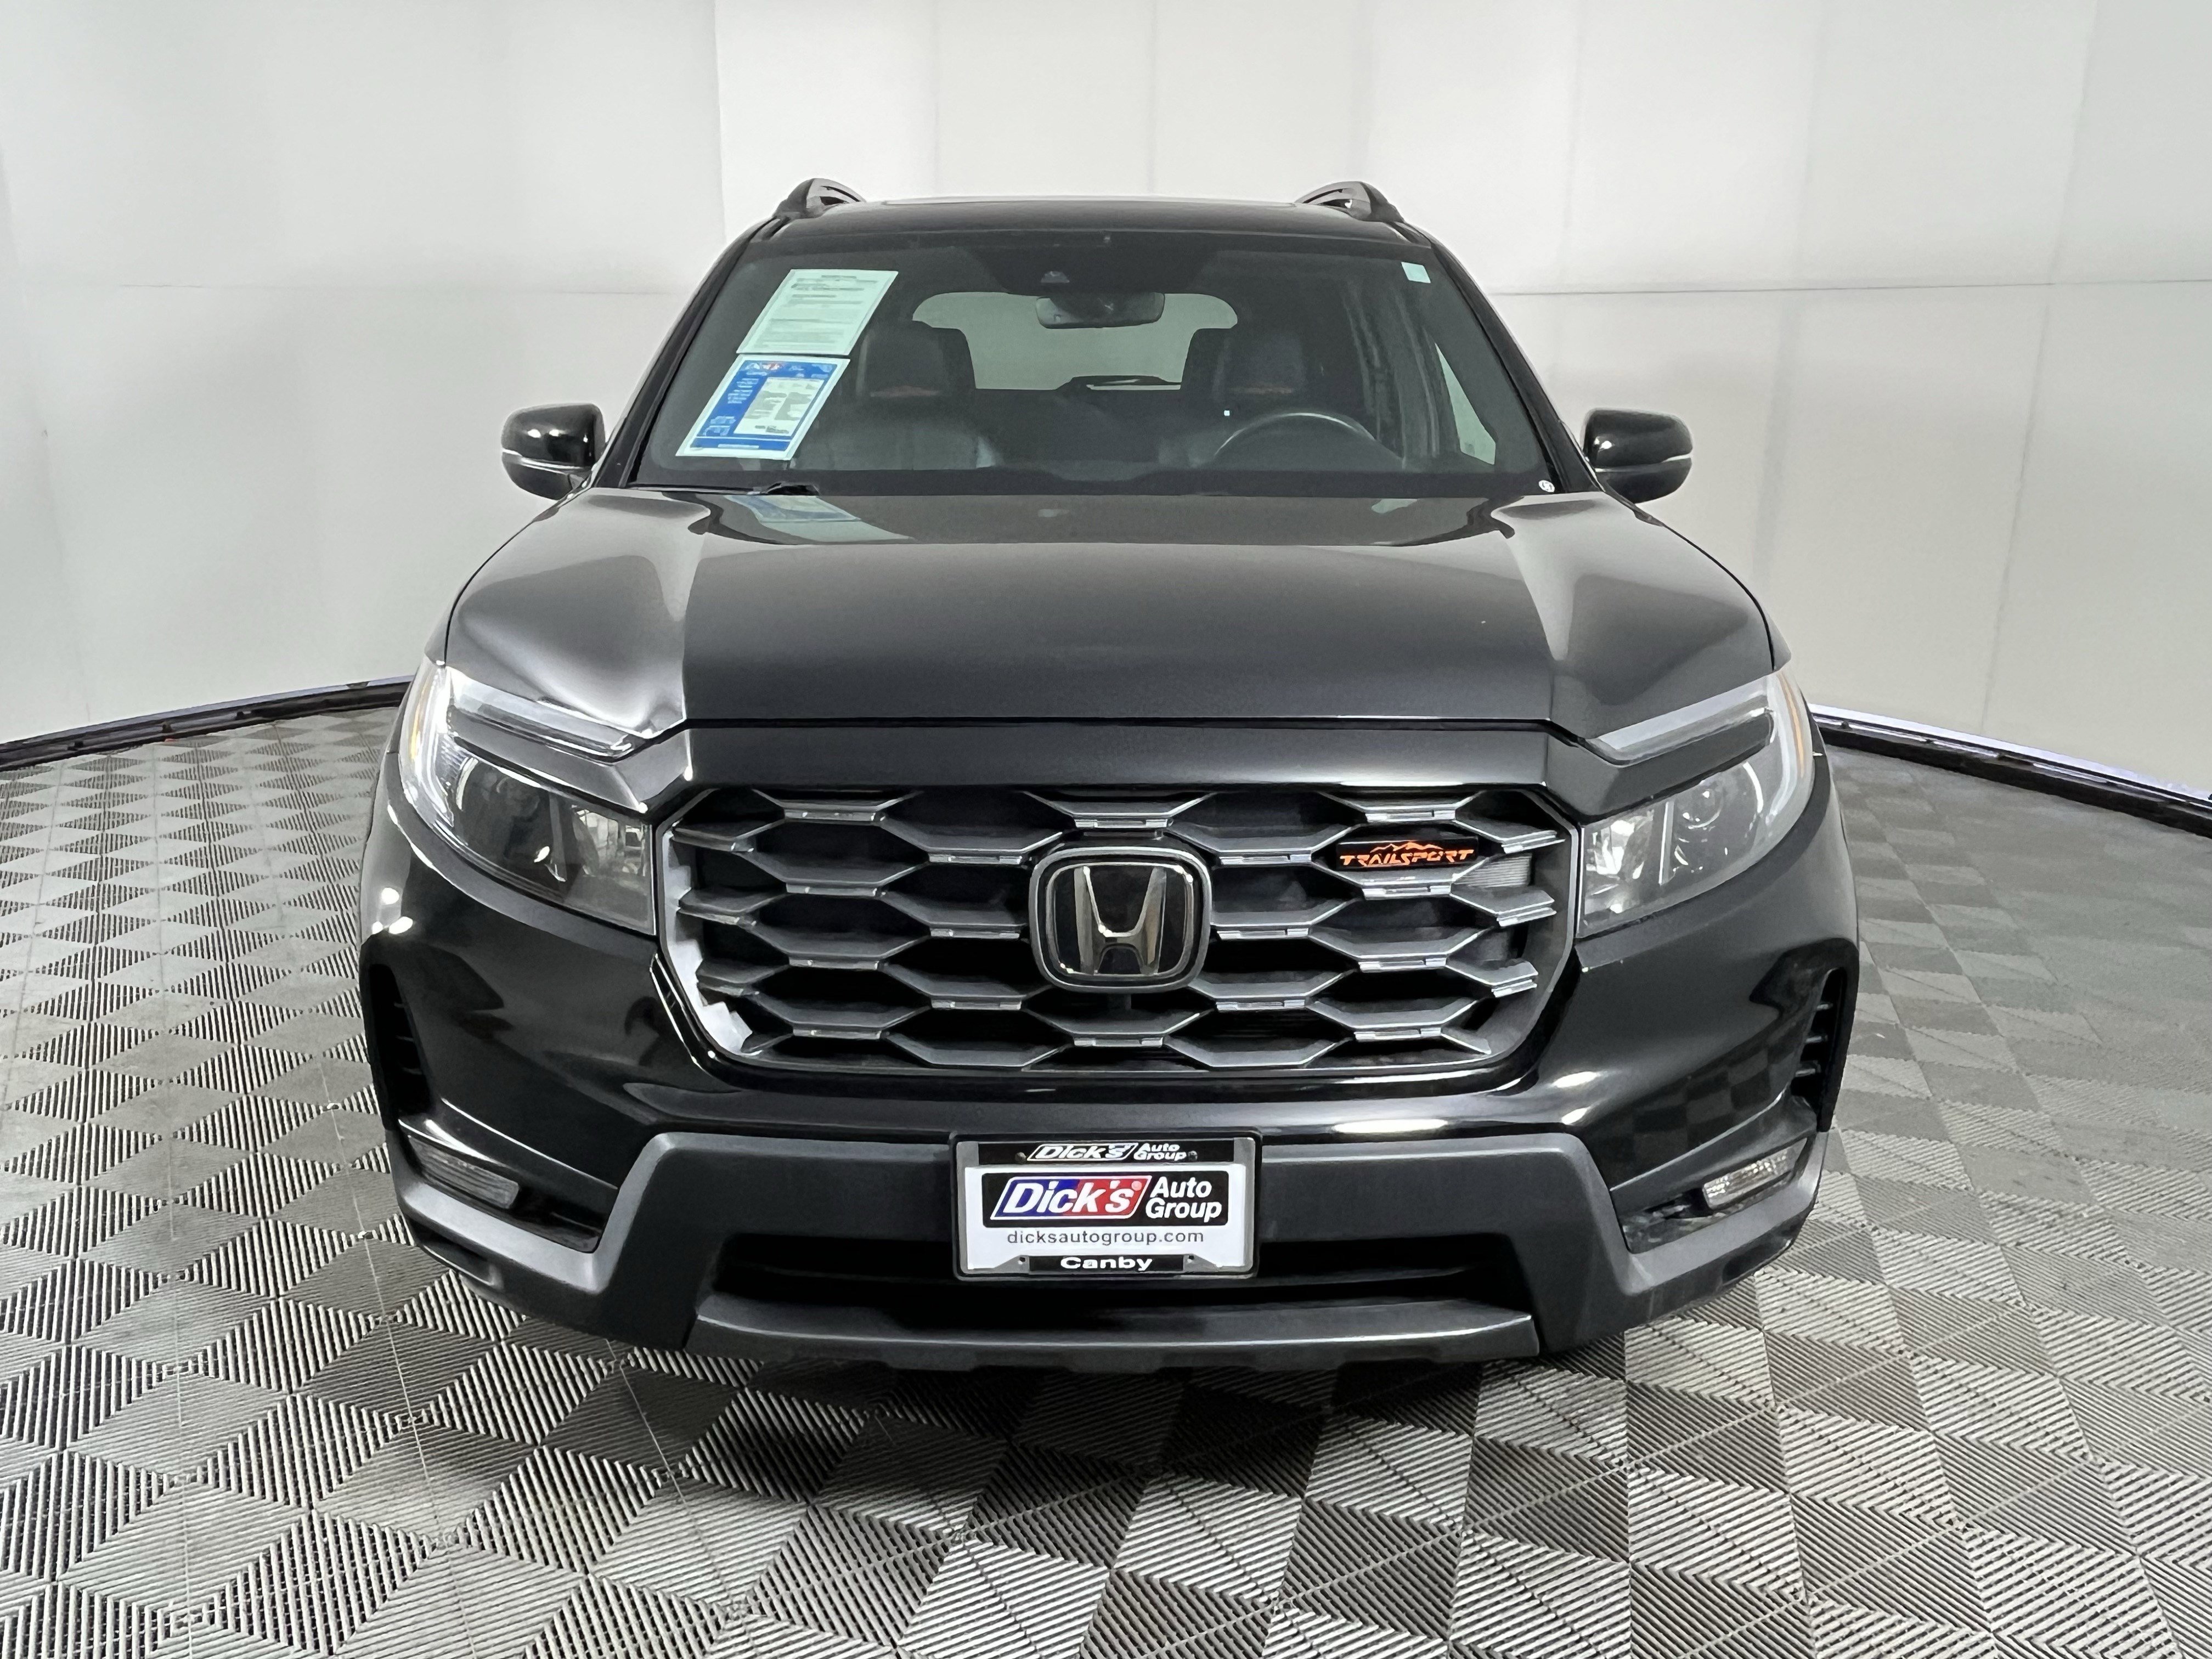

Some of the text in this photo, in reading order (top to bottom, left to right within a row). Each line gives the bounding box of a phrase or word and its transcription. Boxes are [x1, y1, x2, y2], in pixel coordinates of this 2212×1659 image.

[1340, 850, 1474, 867] TRAILSPORT
[1133, 1150, 1187, 1161] Group
[1138, 1143, 1180, 1152] Auto
[1150, 1176, 1212, 1198] Auto
[1146, 1198, 1222, 1222] Group
[1007, 1230, 1204, 1245] dicksautogroup.com
[1060, 1256, 1153, 1272] Canby
